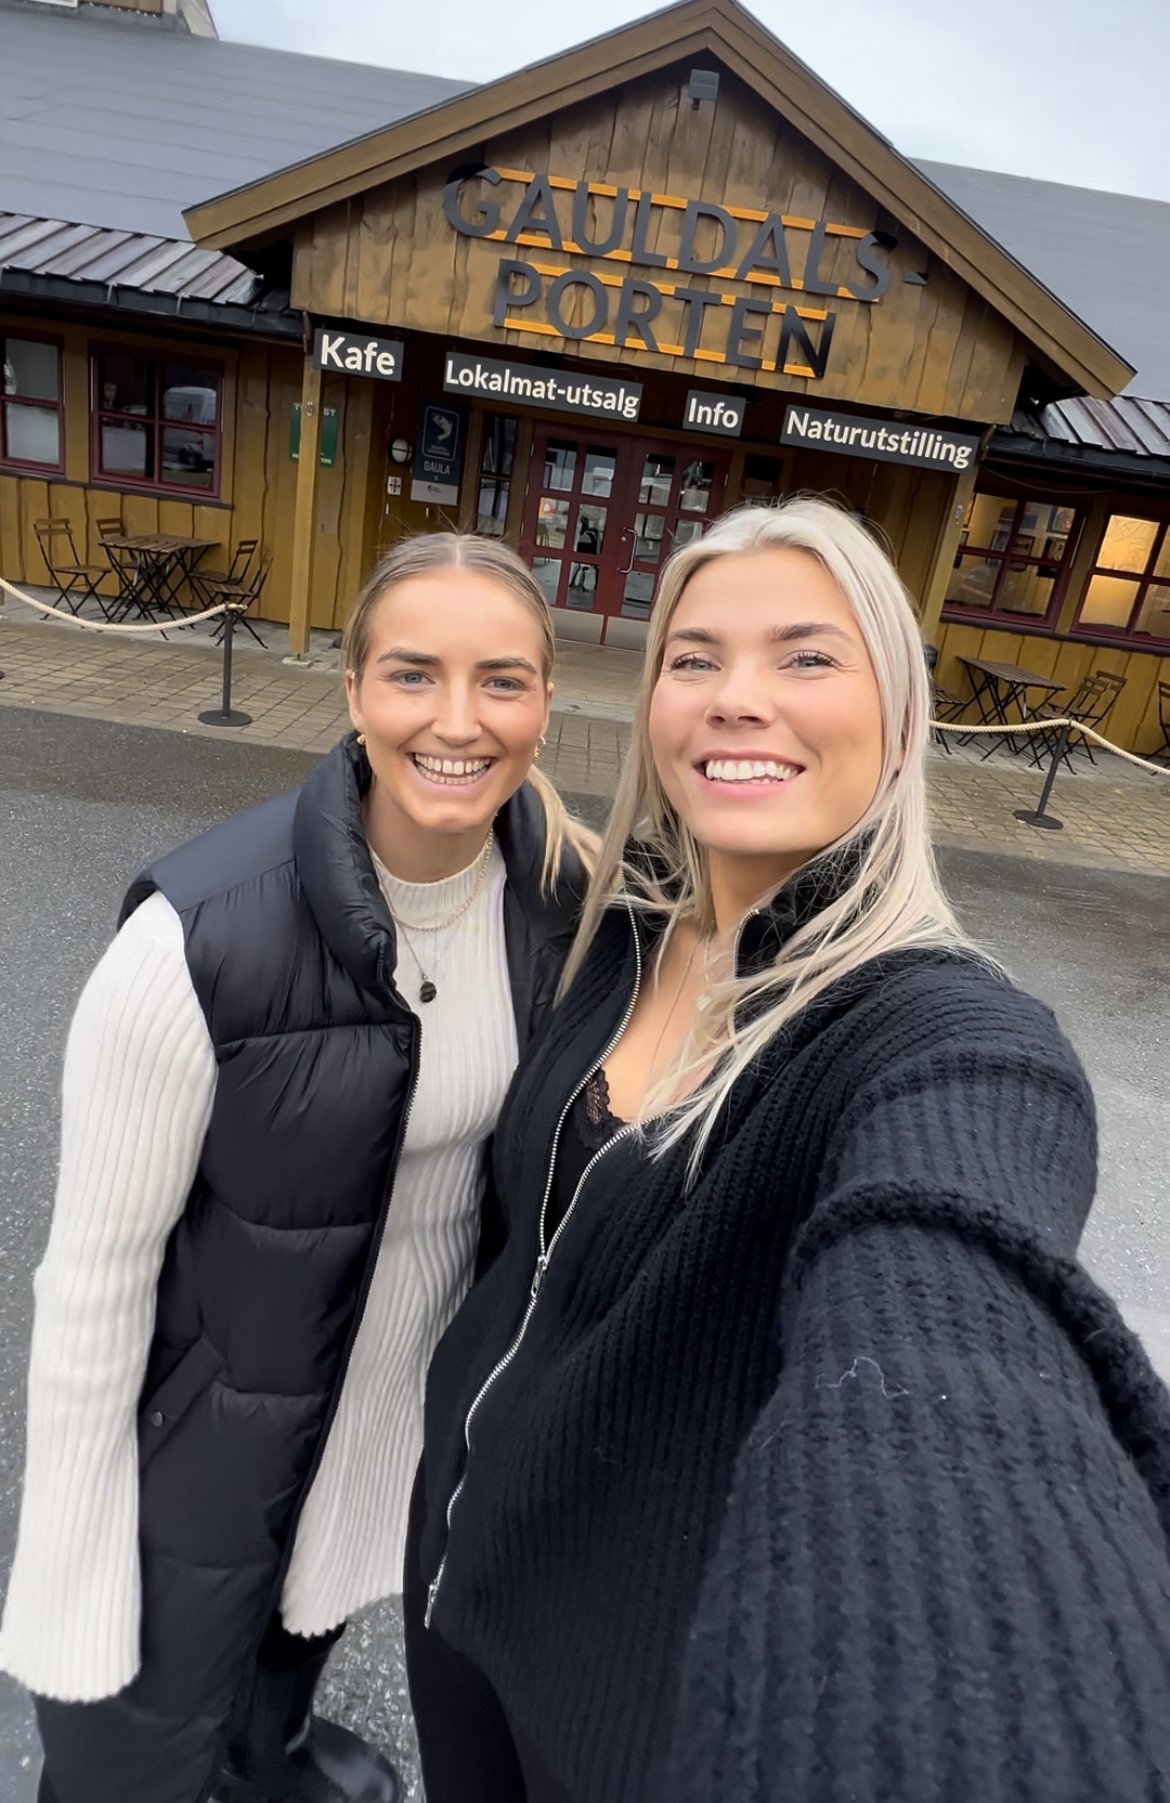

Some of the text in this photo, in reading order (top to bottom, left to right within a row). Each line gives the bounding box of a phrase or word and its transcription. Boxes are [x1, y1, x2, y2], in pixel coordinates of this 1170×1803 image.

[443, 163, 928, 301] GAULDALS-
[493, 259, 836, 379] PORTEN
[321, 334, 395, 375] Kafe
[446, 360, 639, 419] Lokalmat-utsalg
[688, 398, 739, 428] Info
[423, 460, 451, 475] GAULA
[786, 410, 972, 470] Naturutstilling
